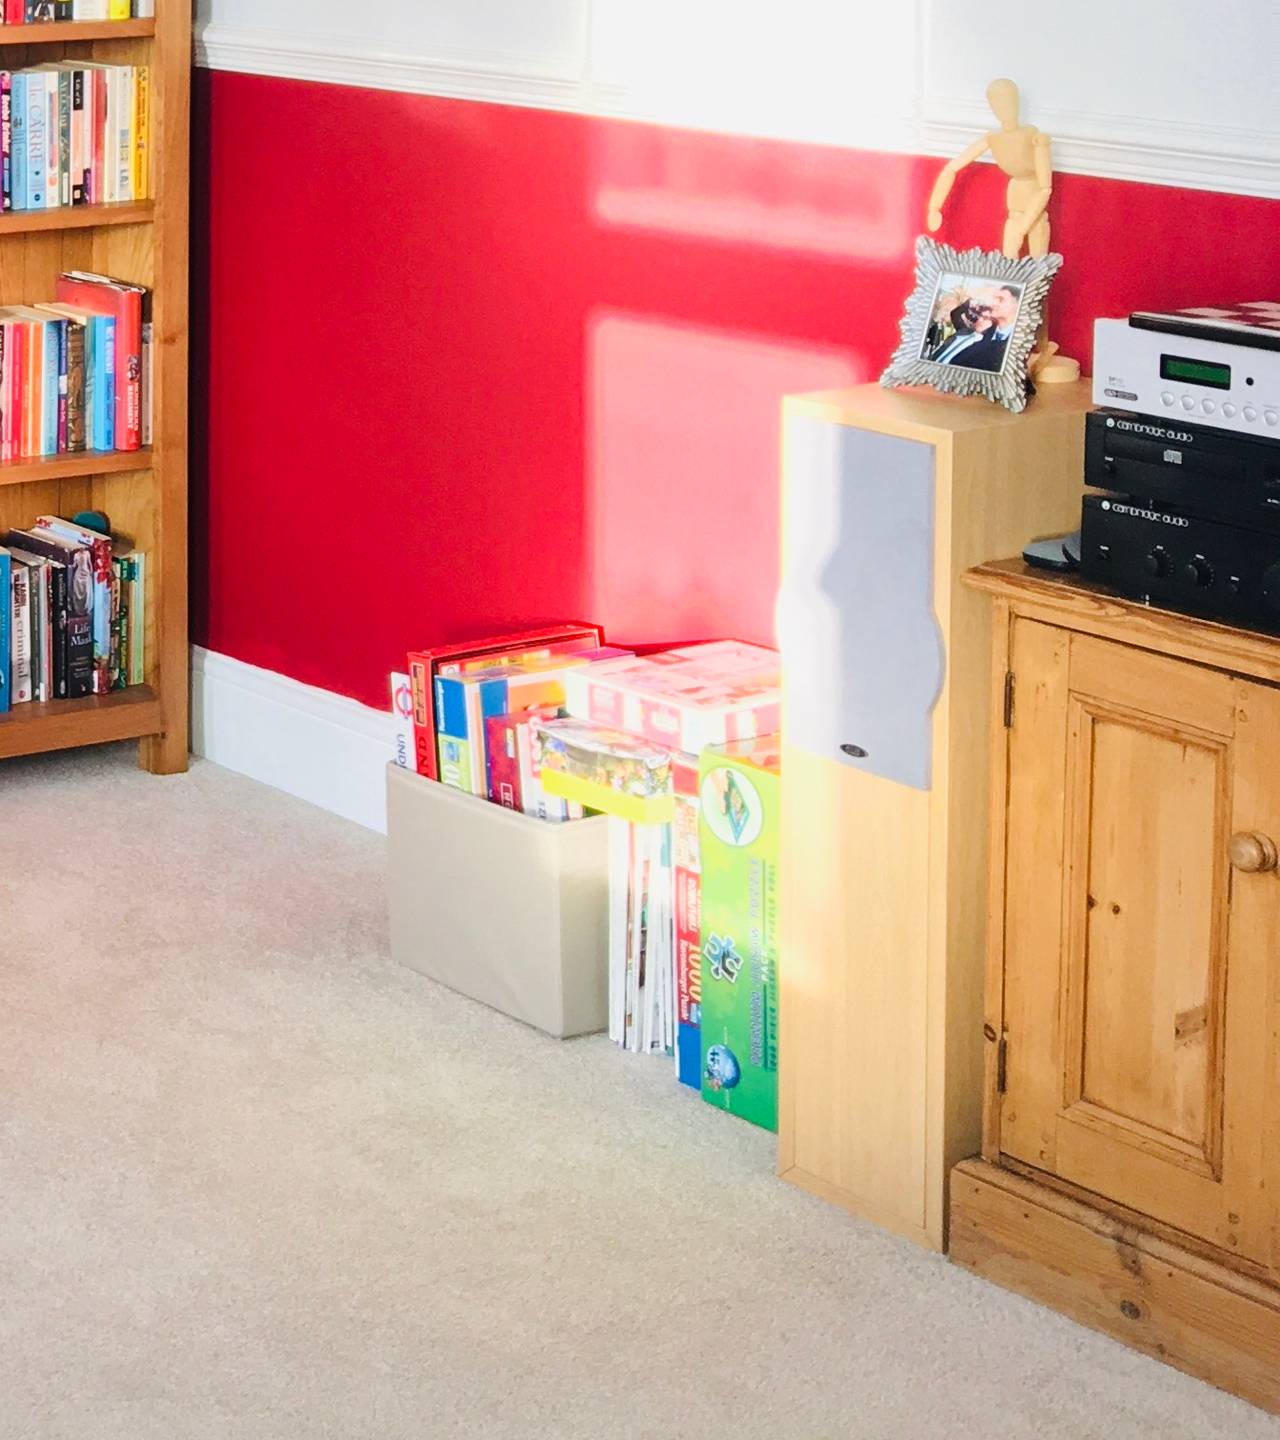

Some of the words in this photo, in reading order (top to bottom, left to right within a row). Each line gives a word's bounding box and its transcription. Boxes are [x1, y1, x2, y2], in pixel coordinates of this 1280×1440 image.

[1166, 429, 1194, 443] audio
[1161, 513, 1190, 528] audio
[16, 619, 28, 679] criminal
[688, 944, 702, 1002] 1000
[759, 951, 769, 982] PACK
